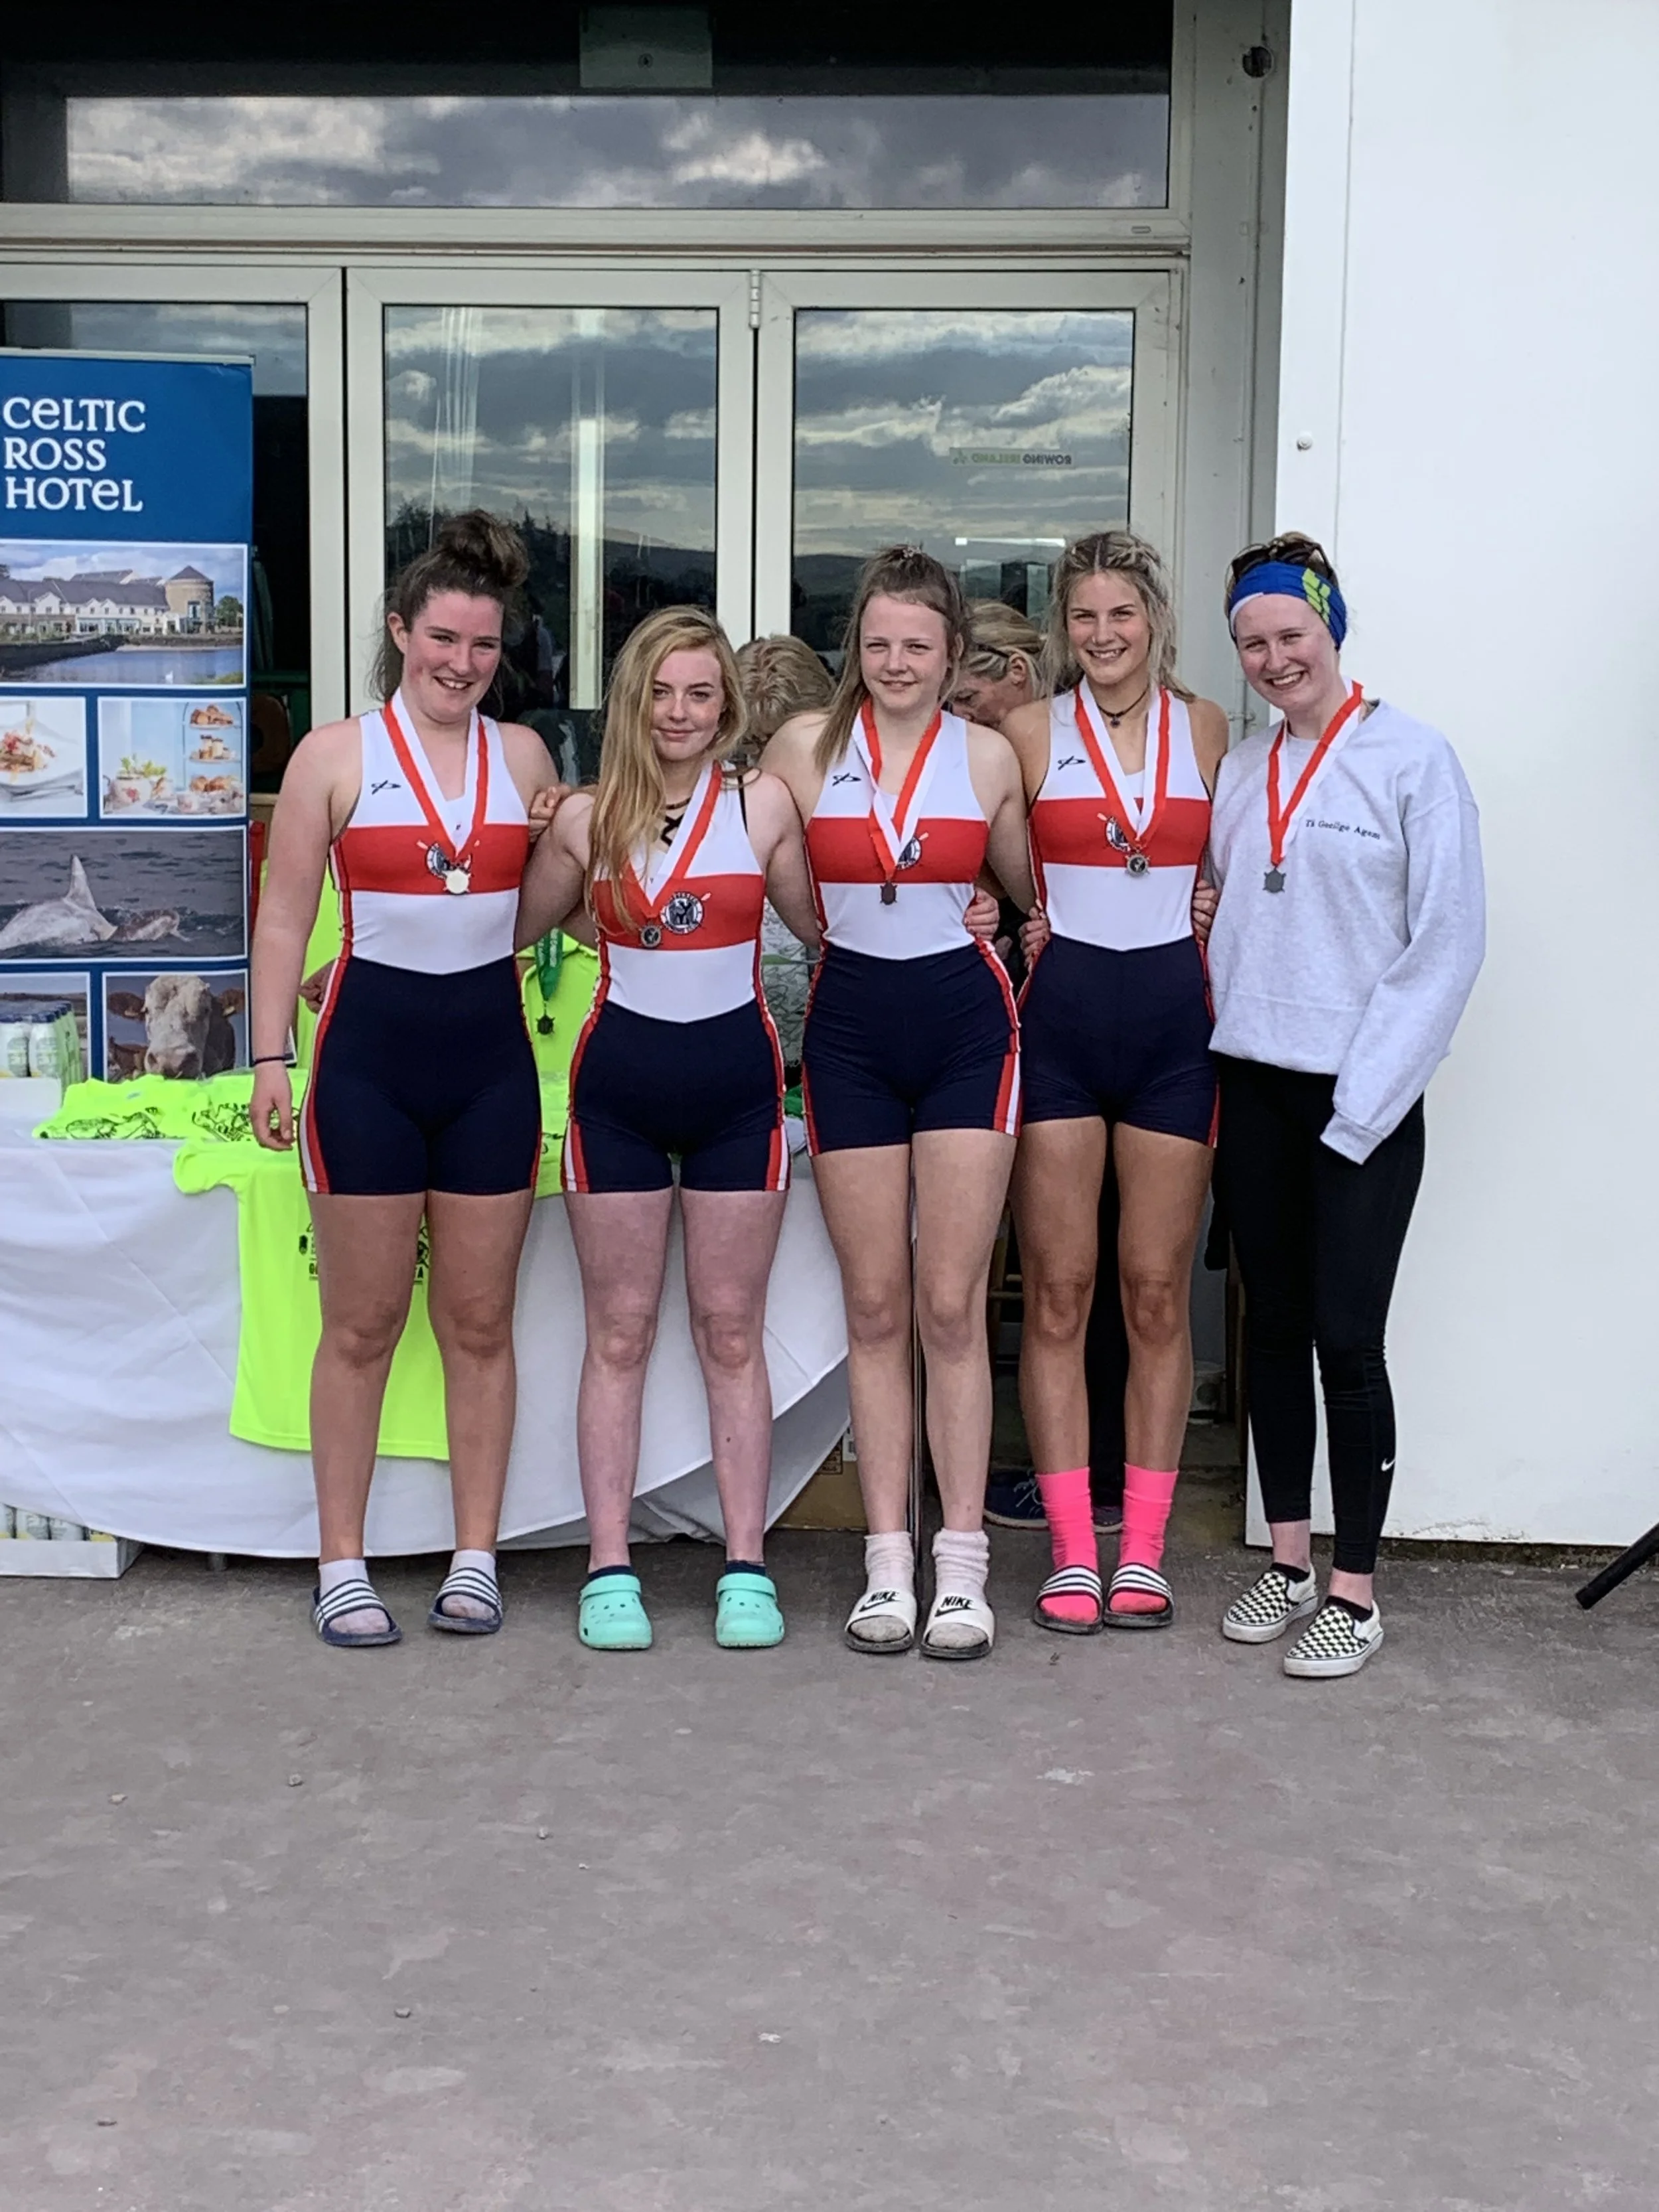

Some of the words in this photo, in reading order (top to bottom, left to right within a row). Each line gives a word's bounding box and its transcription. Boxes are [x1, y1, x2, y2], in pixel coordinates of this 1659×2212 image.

[4, 437, 107, 472] ROSS
[867, 1591, 899, 1603] NIKE
[941, 1596, 974, 1610] NIKE
